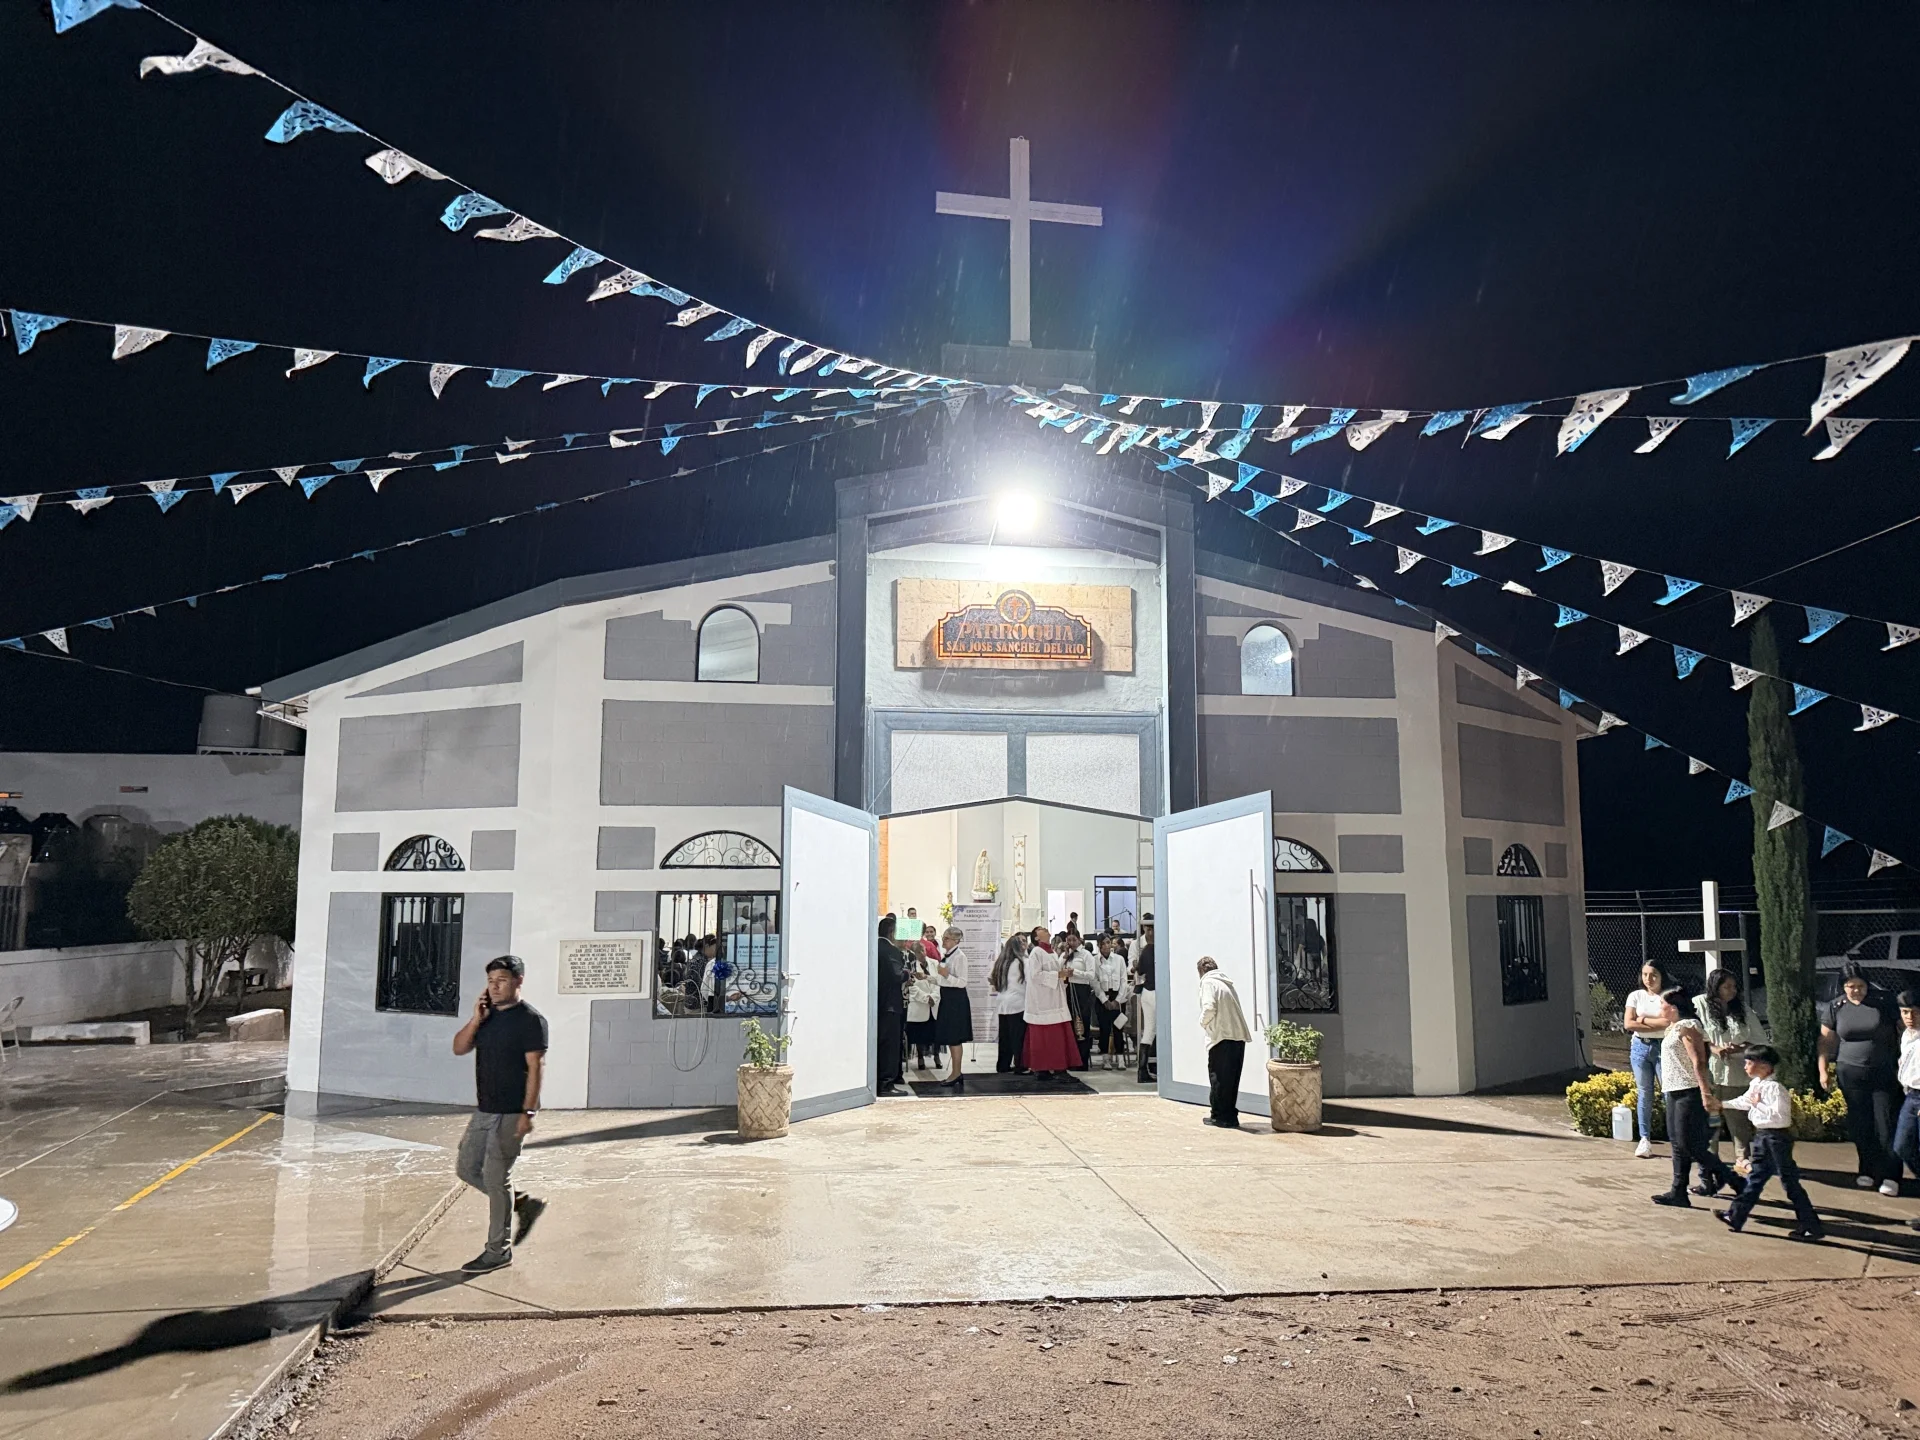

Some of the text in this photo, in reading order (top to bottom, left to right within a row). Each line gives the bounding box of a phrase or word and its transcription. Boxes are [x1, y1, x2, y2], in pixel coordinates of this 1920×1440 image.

[959, 623, 1074, 641] PARROQUIA
[946, 641, 966, 652] SAN
[996, 642, 1040, 653] SANCHEZ
[1043, 643, 1062, 654] DEL
